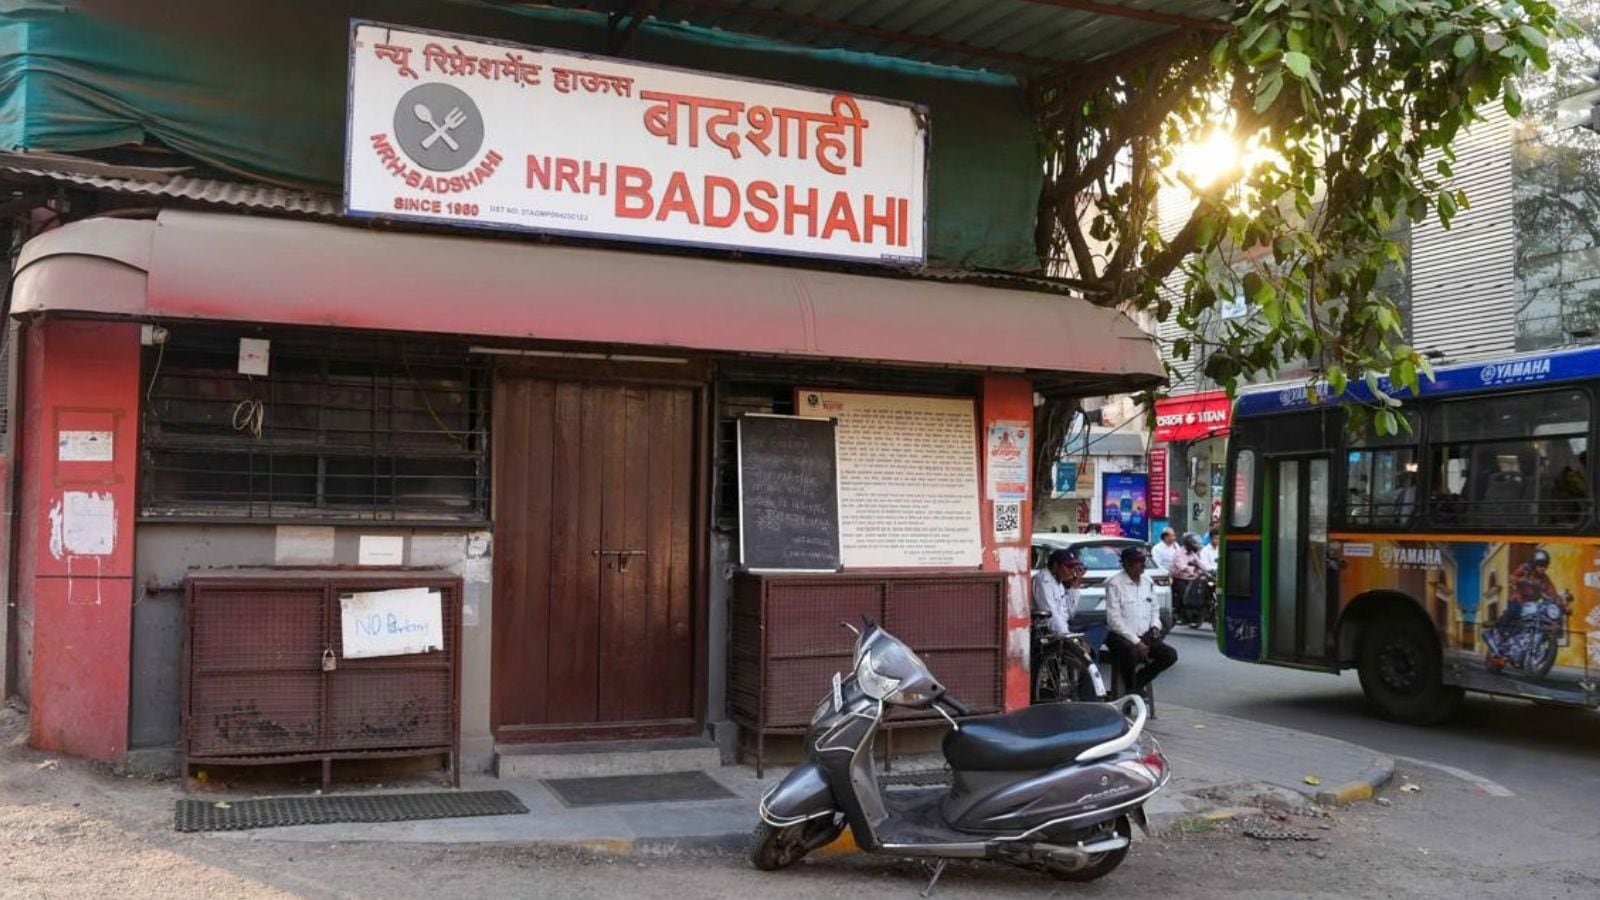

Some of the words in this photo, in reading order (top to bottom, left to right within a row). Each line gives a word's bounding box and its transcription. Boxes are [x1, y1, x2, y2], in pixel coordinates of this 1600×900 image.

[374, 42, 418, 80] न्यू
[640, 91, 870, 175] बादशाही
[370, 132, 504, 194] NRH-BADSHAHI
[394, 197, 441, 213] SINCE
[526, 154, 608, 196] NRH
[614, 163, 909, 247] BADSHAHI
[1497, 358, 1551, 378] YAMAHA
[1393, 547, 1442, 565] YAMAHA
[355, 613, 382, 636] NO
